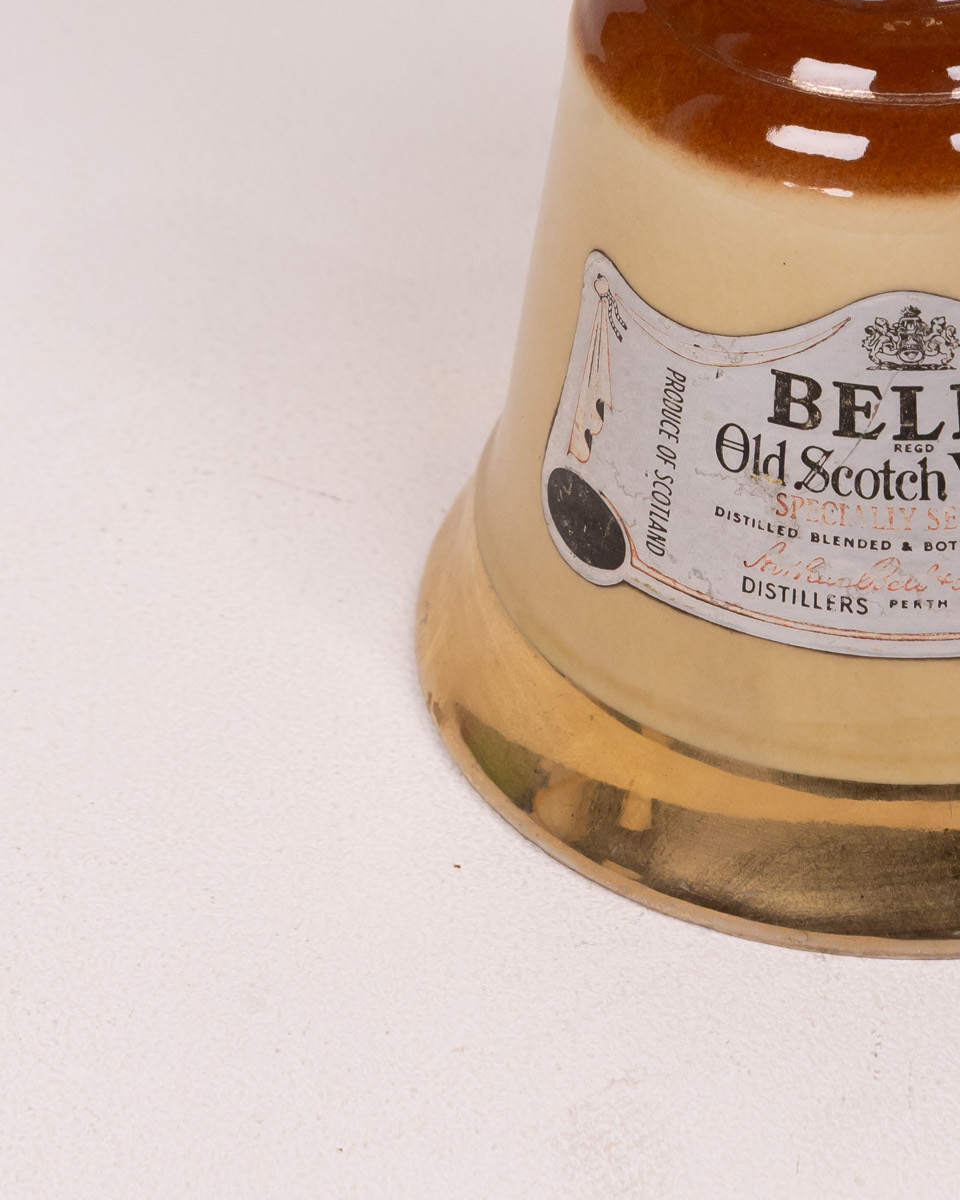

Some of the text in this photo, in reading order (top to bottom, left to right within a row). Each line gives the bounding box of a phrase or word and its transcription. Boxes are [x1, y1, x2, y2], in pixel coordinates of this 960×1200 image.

[645, 366, 687, 557] PRODUCE OF SCOTLAND
[715, 423, 787, 486] Old
[794, 445, 948, 501] Scotch
[894, 443, 934, 453] REGD
[714, 505, 799, 538] DISTILLED
[811, 532, 892, 551] BLENDED
[901, 541, 913, 552] &
[742, 575, 868, 615] DISTILLERS
[889, 599, 948, 609] PERTH
